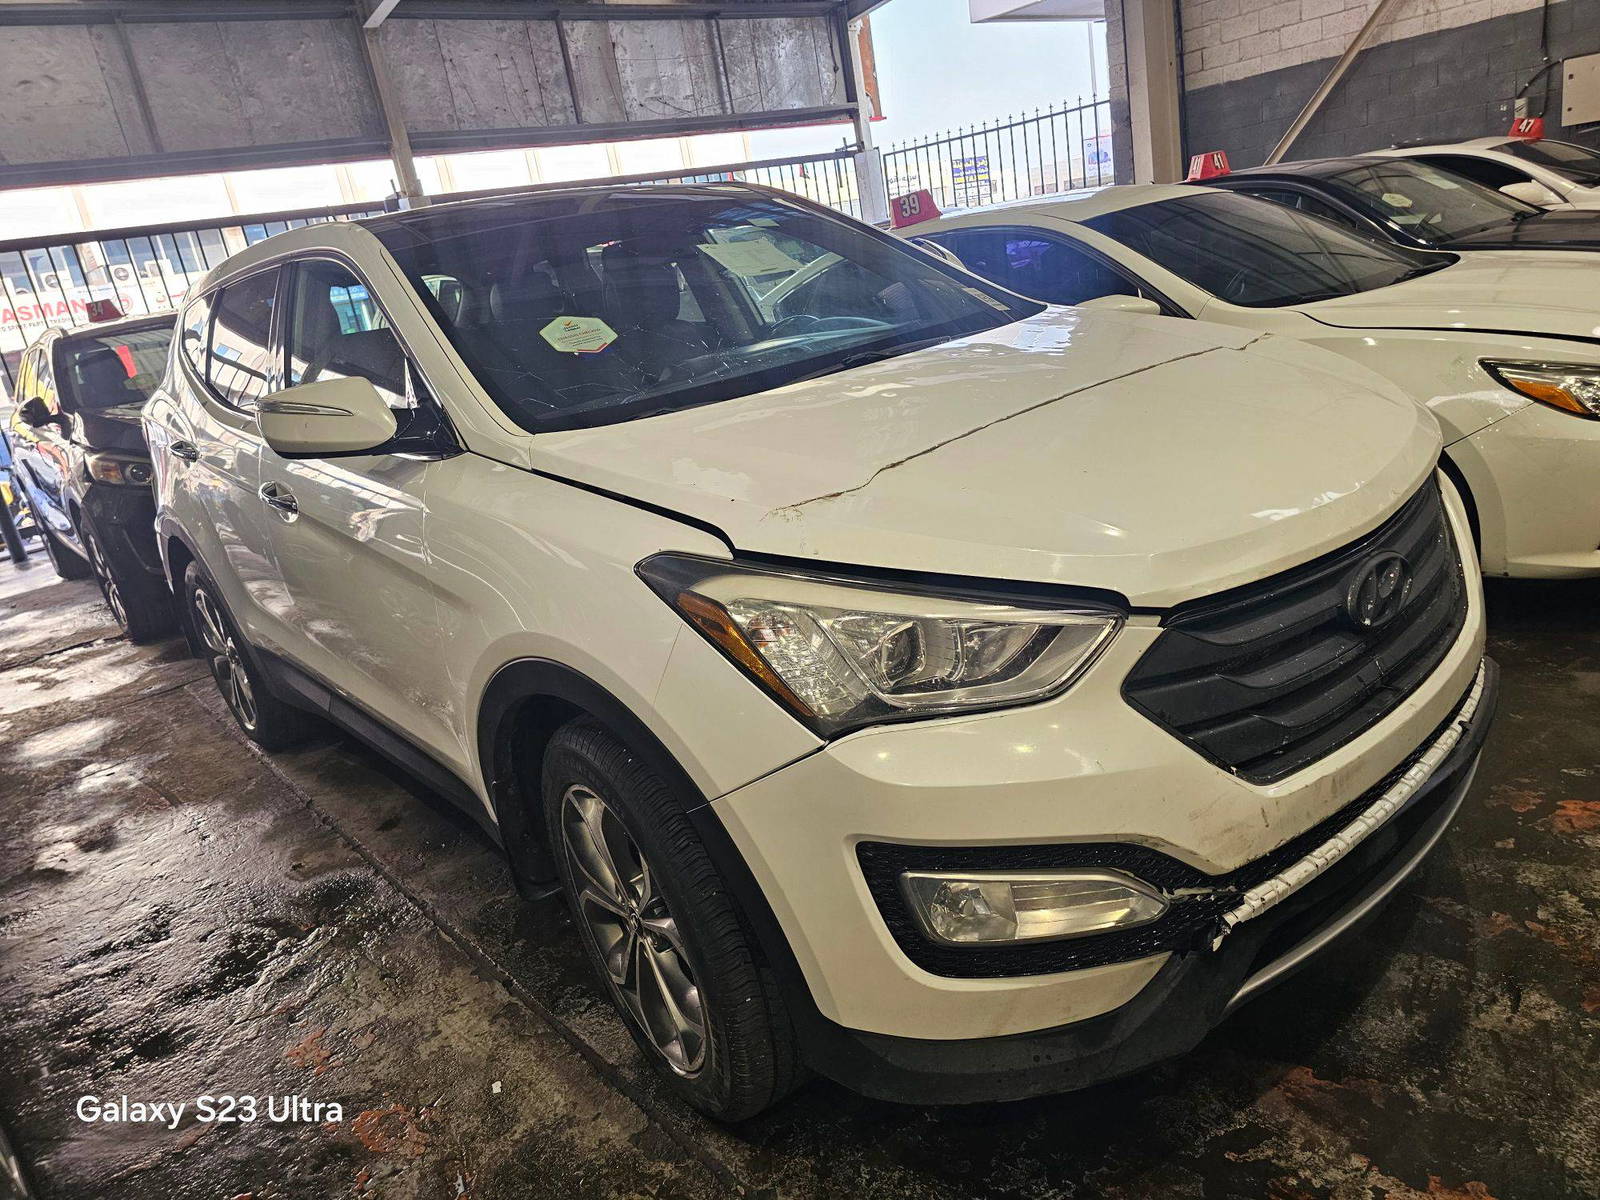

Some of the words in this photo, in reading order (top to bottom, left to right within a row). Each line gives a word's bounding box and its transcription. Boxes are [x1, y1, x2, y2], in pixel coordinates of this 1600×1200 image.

[1518, 118, 1536, 134] 47
[1213, 152, 1225, 169] 41
[900, 194, 921, 218] 39
[1, 298, 88, 324] ASMAN
[91, 301, 104, 317] 34
